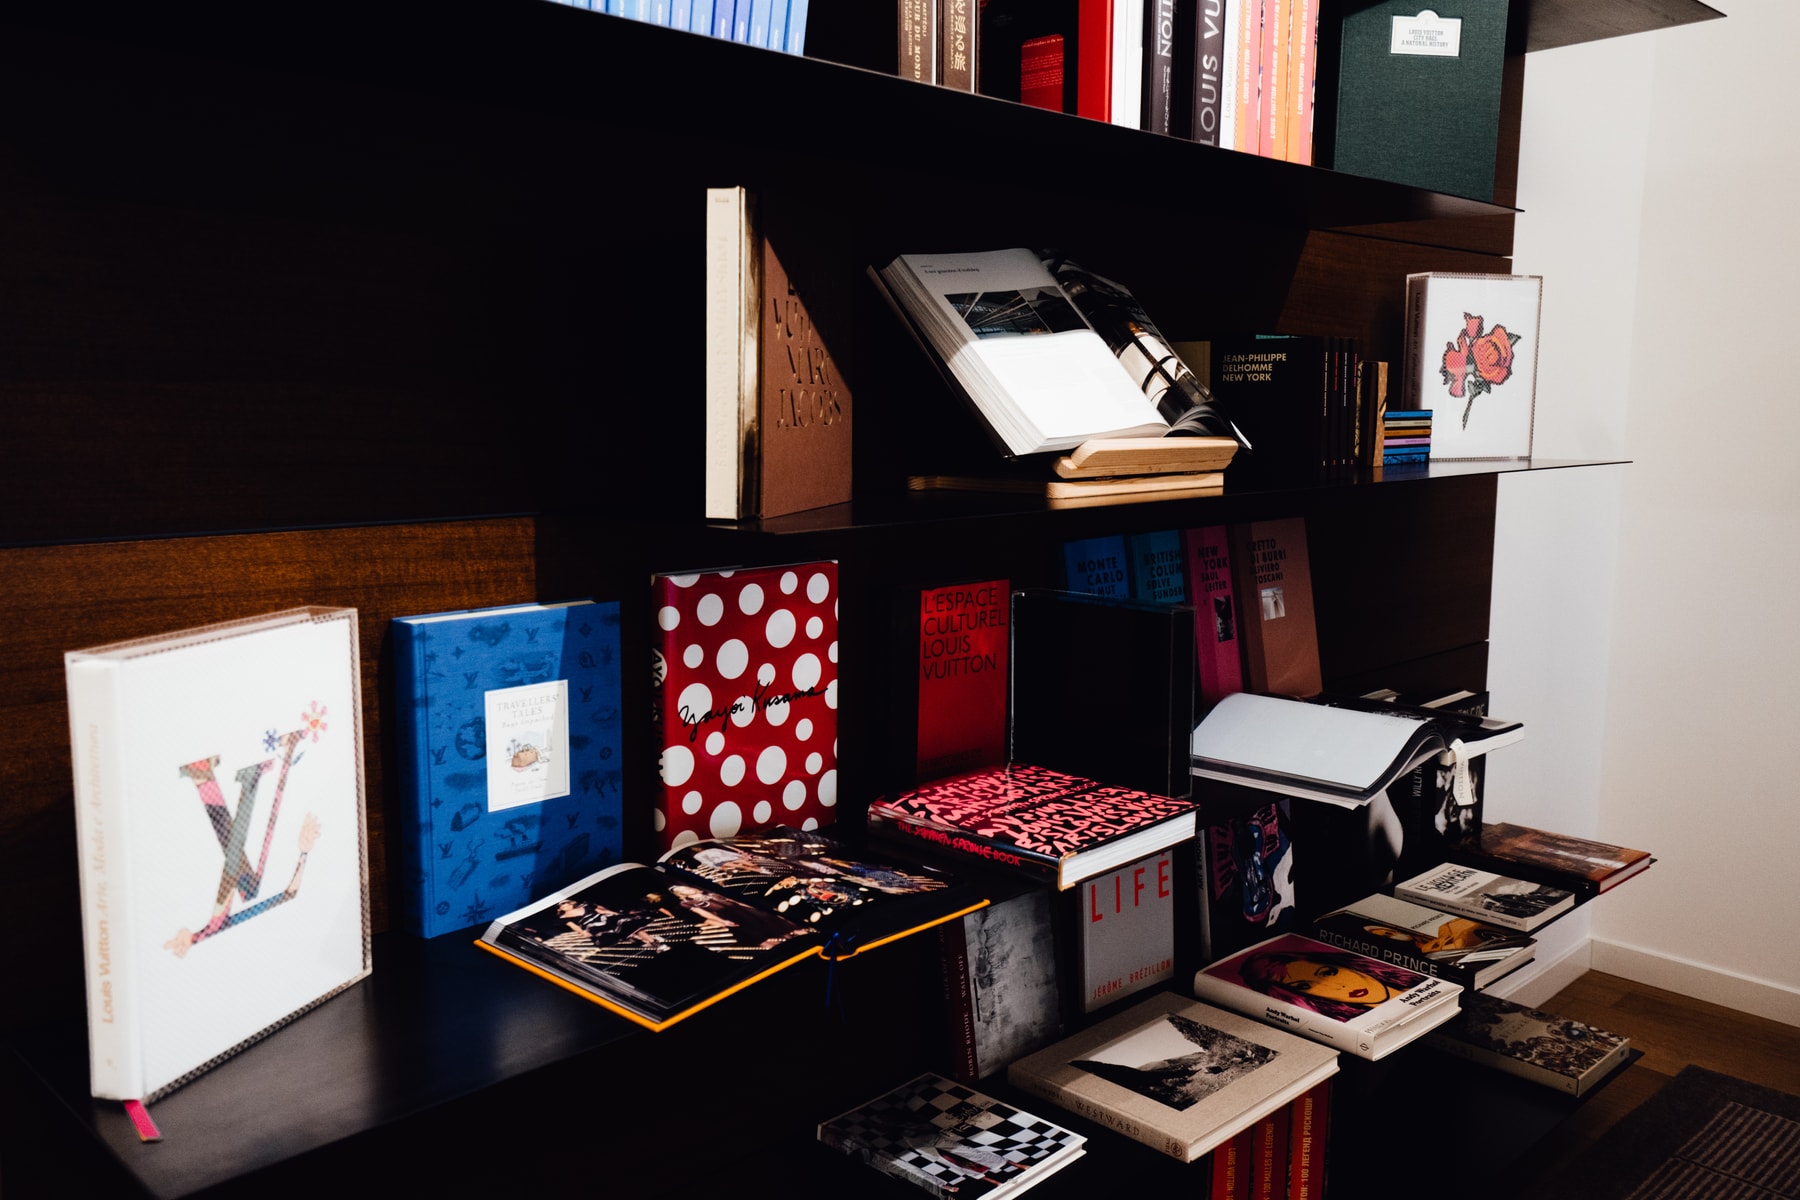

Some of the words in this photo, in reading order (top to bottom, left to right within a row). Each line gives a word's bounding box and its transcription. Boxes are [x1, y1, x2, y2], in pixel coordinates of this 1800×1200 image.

[914, 25, 921, 41] DU
[1200, 54, 1218, 146] LOUIS
[1223, 353, 1287, 363] JEAN-PHILIPPE
[1223, 364, 1273, 372] DELHOMME
[1223, 374, 1244, 382] NEW
[1246, 373, 1272, 382] YORK
[1143, 550, 1183, 566] BRITISH
[1198, 546, 1218, 559] NEW
[1203, 557, 1229, 571] YORK
[1262, 549, 1287, 563] BURRI
[1078, 556, 1117, 573] MONTE
[1087, 569, 1124, 586] CARLO
[1204, 581, 1228, 593] LEITER
[1254, 572, 1283, 584] TOSCANI
[925, 588, 998, 614] L'ESPACE
[924, 609, 1006, 637] CULTUREL
[924, 635, 970, 659] LOUIS
[922, 652, 997, 680] VUITTON
[512, 706, 543, 719] TALES
[1412, 775, 1422, 797] WILLY
[897, 821, 912, 834] THE
[914, 827, 951, 846] STEPHEN
[952, 837, 991, 859] SPROUSE
[993, 850, 1021, 867] BOOK
[1194, 837, 1202, 861] MODE
[1091, 860, 1169, 923] LIFE
[98, 919, 111, 978] Vuitton
[1320, 930, 1379, 958] RICHARD
[1384, 950, 1439, 978] PRINCE
[1093, 978, 1123, 1000] JÉRÔME
[1130, 959, 1171, 984] BRÉZILLON
[101, 981, 114, 1025] Louis
[1400, 990, 1419, 1004] Andy
[1417, 980, 1441, 996] Warhol
[1410, 990, 1442, 1007] Portraits
[1265, 1013, 1290, 1025] Portraits
[1266, 1007, 1281, 1018] Andy
[1281, 1012, 1300, 1023] Warhol
[962, 1011, 972, 1045] RHODE
[966, 1047, 975, 1076] ROBIN
[1075, 1101, 1140, 1135] WESTWARD
[1303, 1097, 1313, 1136] РОСКОШИ
[1264, 1122, 1275, 1148] LÉGENDE
[1227, 1147, 1237, 1165] LOUIS
[1265, 1148, 1273, 1157] DE
[1302, 1136, 1313, 1167] ЛЕГЕНД
[1226, 1165, 1235, 1191] VUITTON
[1264, 1159, 1273, 1182] MALLES
